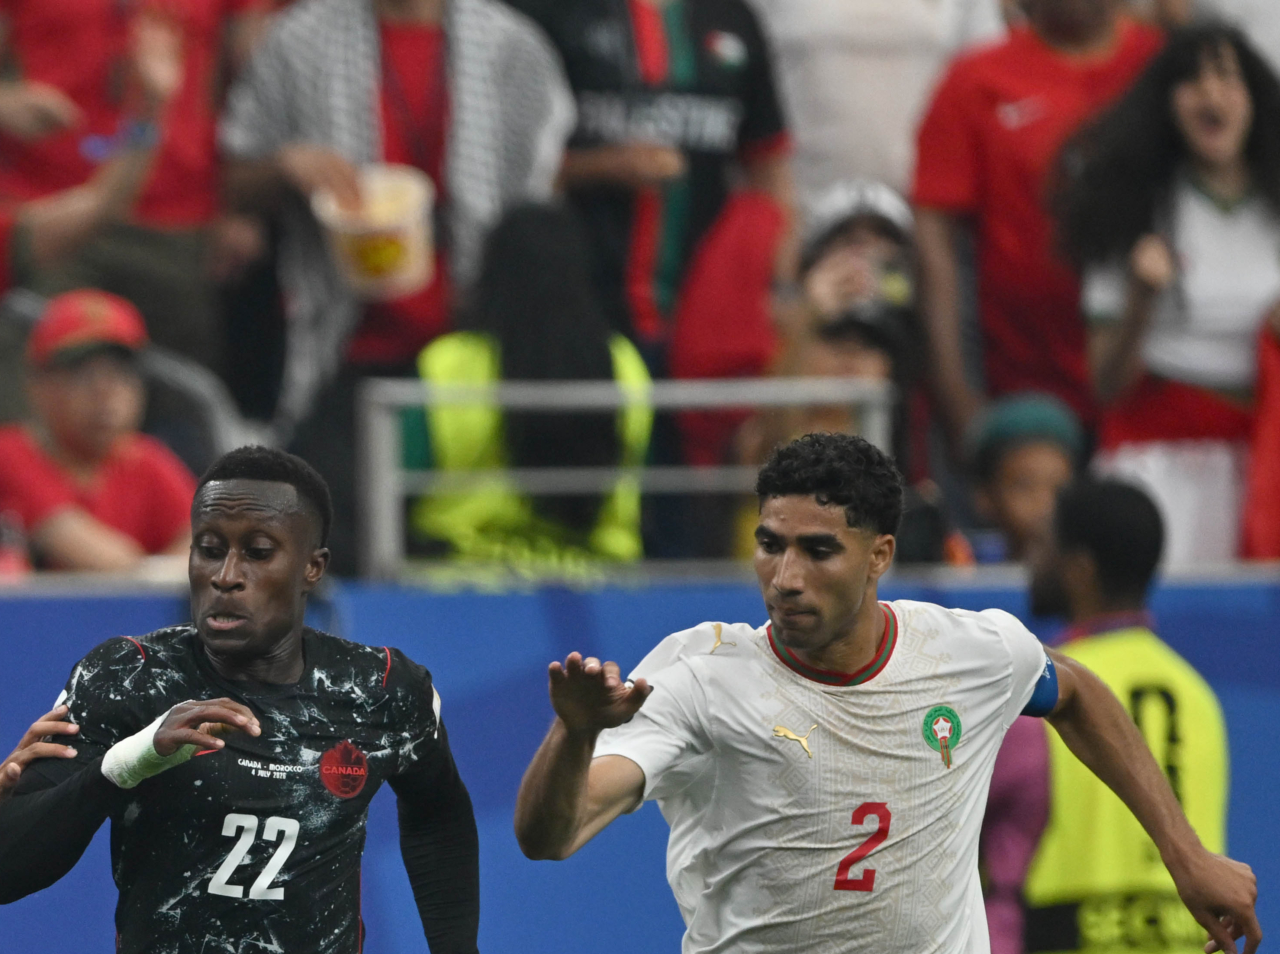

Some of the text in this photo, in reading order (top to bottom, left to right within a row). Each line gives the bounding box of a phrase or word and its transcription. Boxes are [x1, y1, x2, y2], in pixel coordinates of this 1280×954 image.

[237, 758, 262, 769] CANADA
[269, 763, 303, 773] MOROCCO
[322, 764, 366, 776] CANADA
[257, 769, 271, 778] JULY
[833, 802, 892, 892] 2
[207, 812, 300, 901] 22
